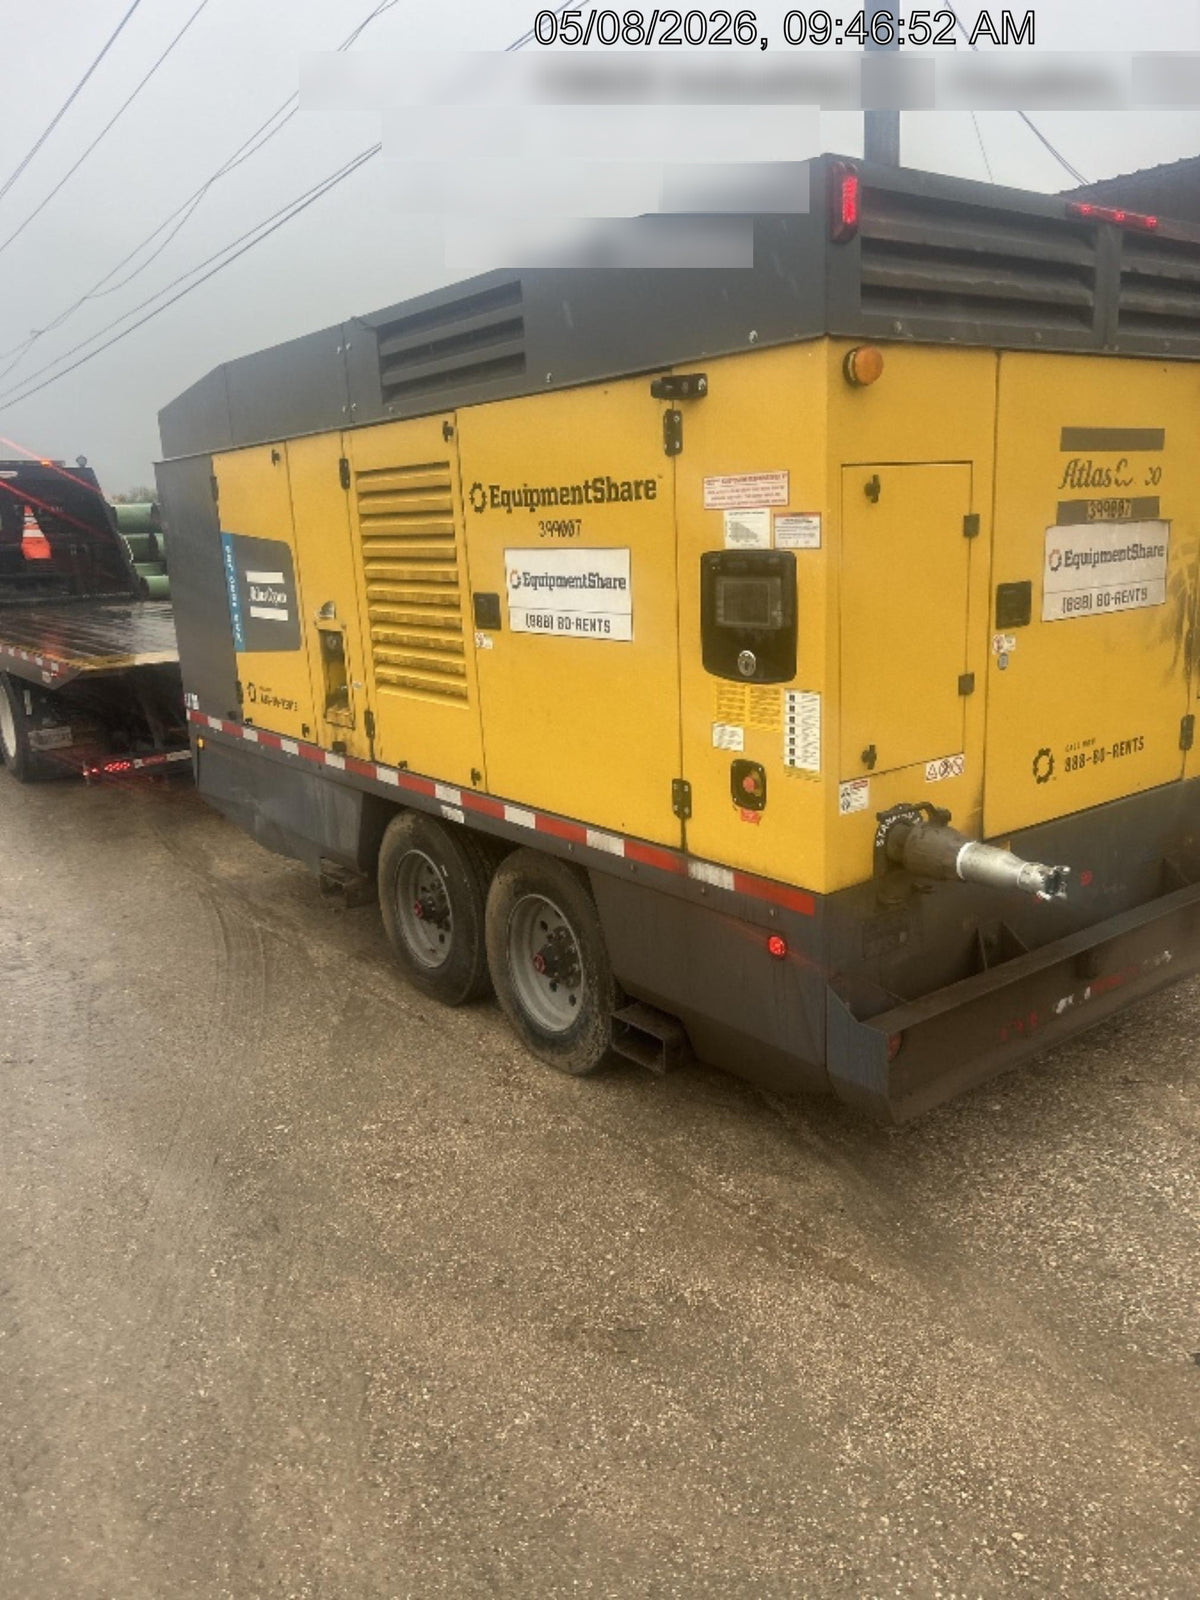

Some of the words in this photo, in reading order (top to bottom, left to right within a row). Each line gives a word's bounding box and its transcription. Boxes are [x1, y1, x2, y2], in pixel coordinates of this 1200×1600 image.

[1058, 458, 1112, 490] Atlas
[488, 476, 657, 513] EquipmentShare
[1064, 543, 1164, 570] EquipmentShare
[522, 571, 627, 591] EquipmentShare
